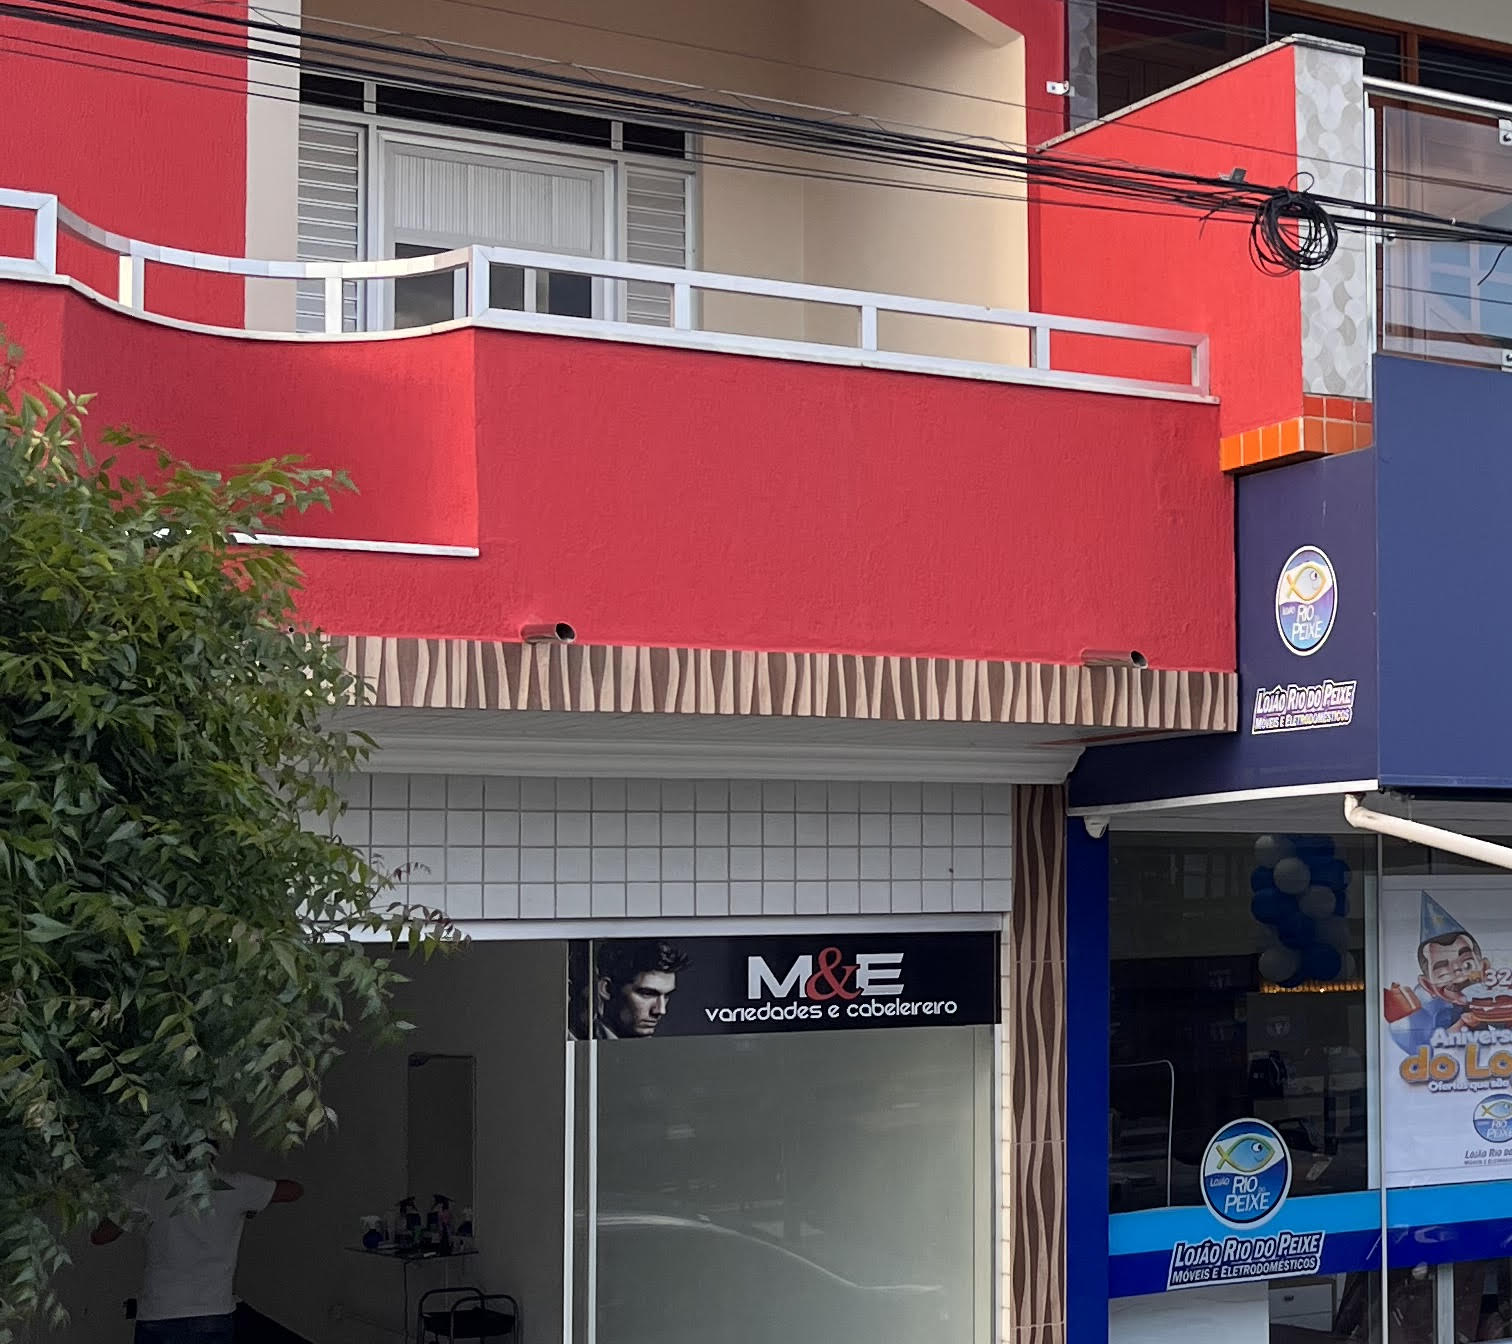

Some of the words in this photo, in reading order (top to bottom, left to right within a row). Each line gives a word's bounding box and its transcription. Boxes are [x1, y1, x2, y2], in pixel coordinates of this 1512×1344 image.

[1287, 686, 1306, 711] RIO
[1308, 686, 1322, 708] DO
[1324, 681, 1354, 706] PEIXE
[747, 946, 905, 1001] M&E
[704, 1001, 823, 1022] variedades
[828, 1004, 840, 1019] e
[846, 997, 958, 1018] cabeleireiro
[1400, 1043, 1460, 1084] do
[1232, 1175, 1258, 1195] RIO
[1224, 1192, 1270, 1214] PEIXE
[1174, 1241, 1221, 1268] LOJÃO
[1223, 1238, 1251, 1263] RIO
[1253, 1238, 1275, 1259] DO
[1278, 1233, 1320, 1256] PEIXE
[1171, 1267, 1210, 1284] MÓVEIS
[1212, 1266, 1219, 1279] E
